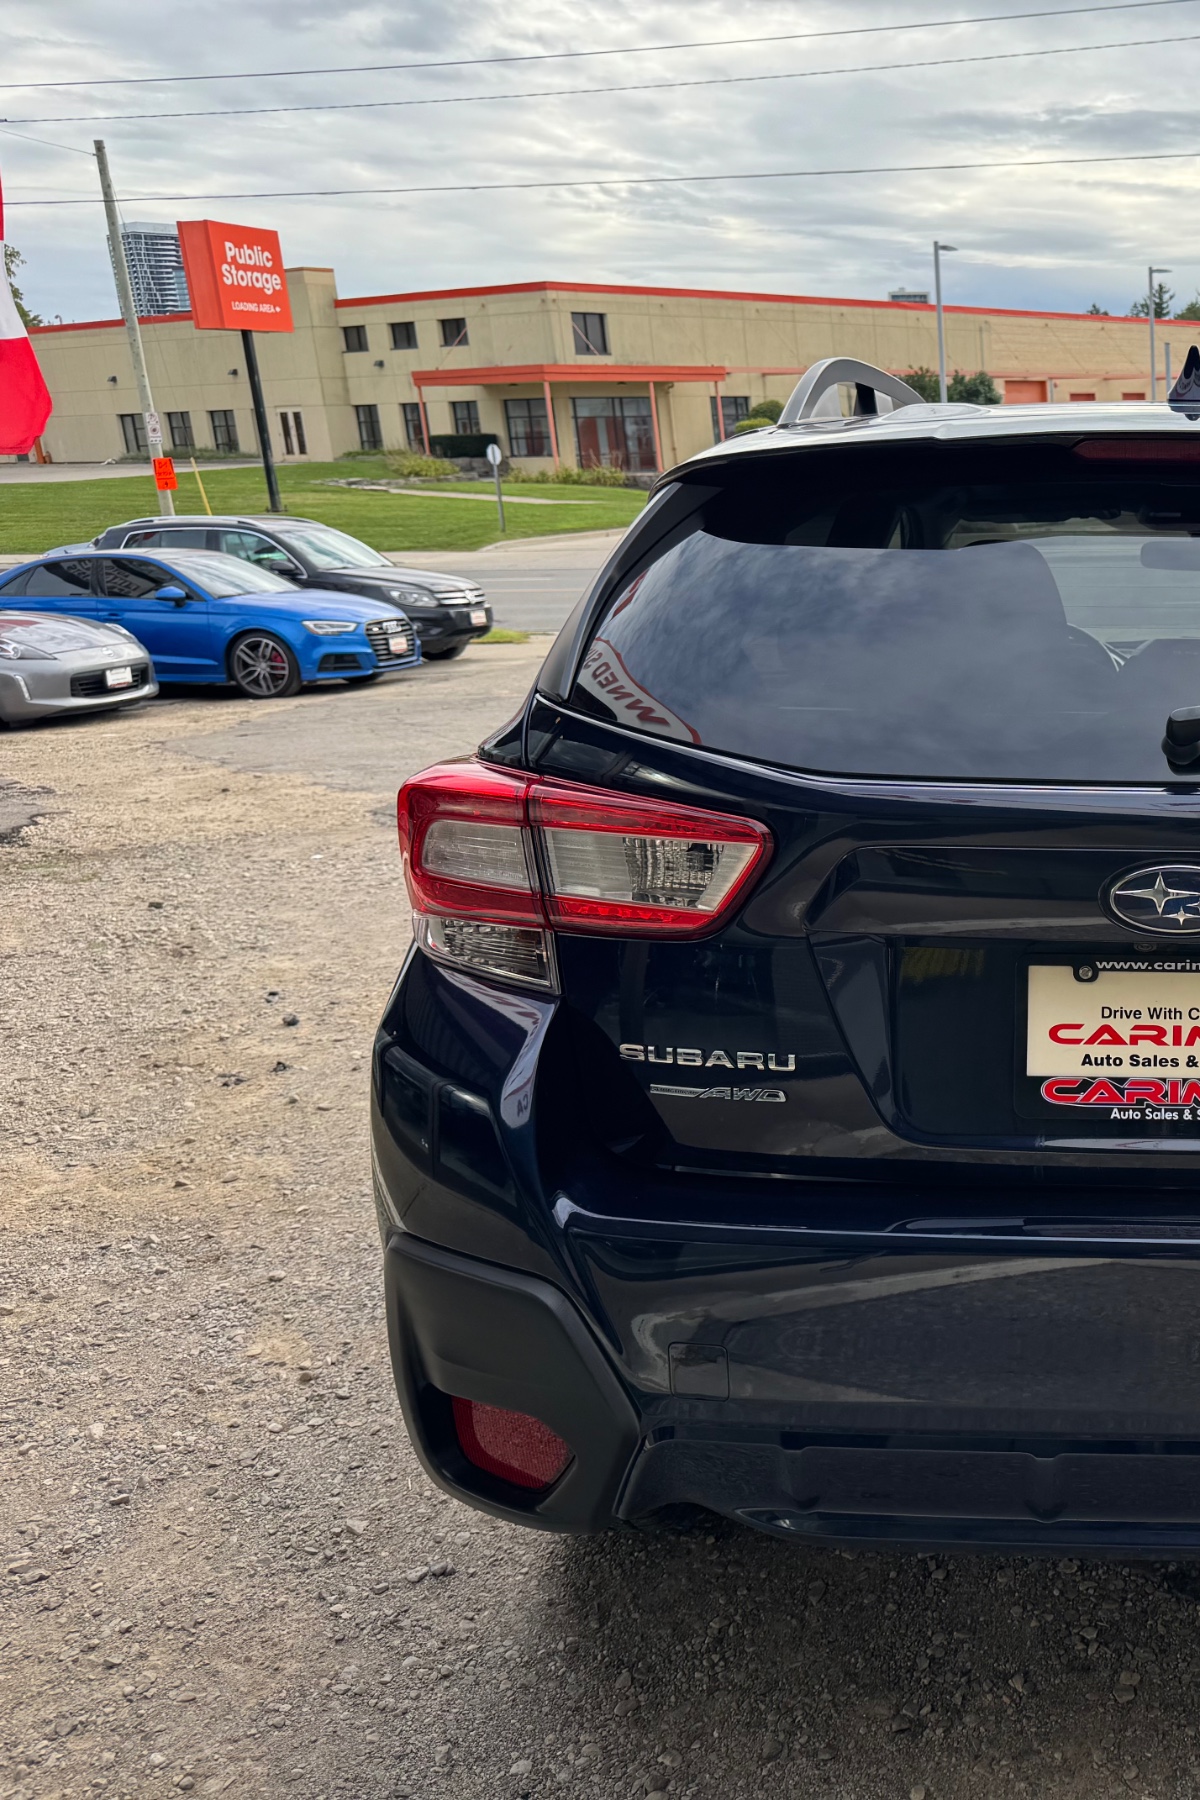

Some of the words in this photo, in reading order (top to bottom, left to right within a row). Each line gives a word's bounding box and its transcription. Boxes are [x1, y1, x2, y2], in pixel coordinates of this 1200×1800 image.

[224, 241, 273, 268] Public
[221, 263, 282, 295] Storage
[231, 301, 259, 312] LOADING
[259, 304, 276, 313] AREA
[1101, 1006, 1142, 1020] Drive
[1147, 1007, 1183, 1020] With
[619, 1043, 796, 1072] SUBARU
[1081, 1053, 1123, 1068] Auto
[1129, 1054, 1180, 1068] Sales
[1185, 1055, 1199, 1068] &
[699, 1086, 787, 1103] AWD
[1110, 1108, 1141, 1120] Auto
[1145, 1108, 1179, 1120] Sales
[1183, 1110, 1193, 1121] &
